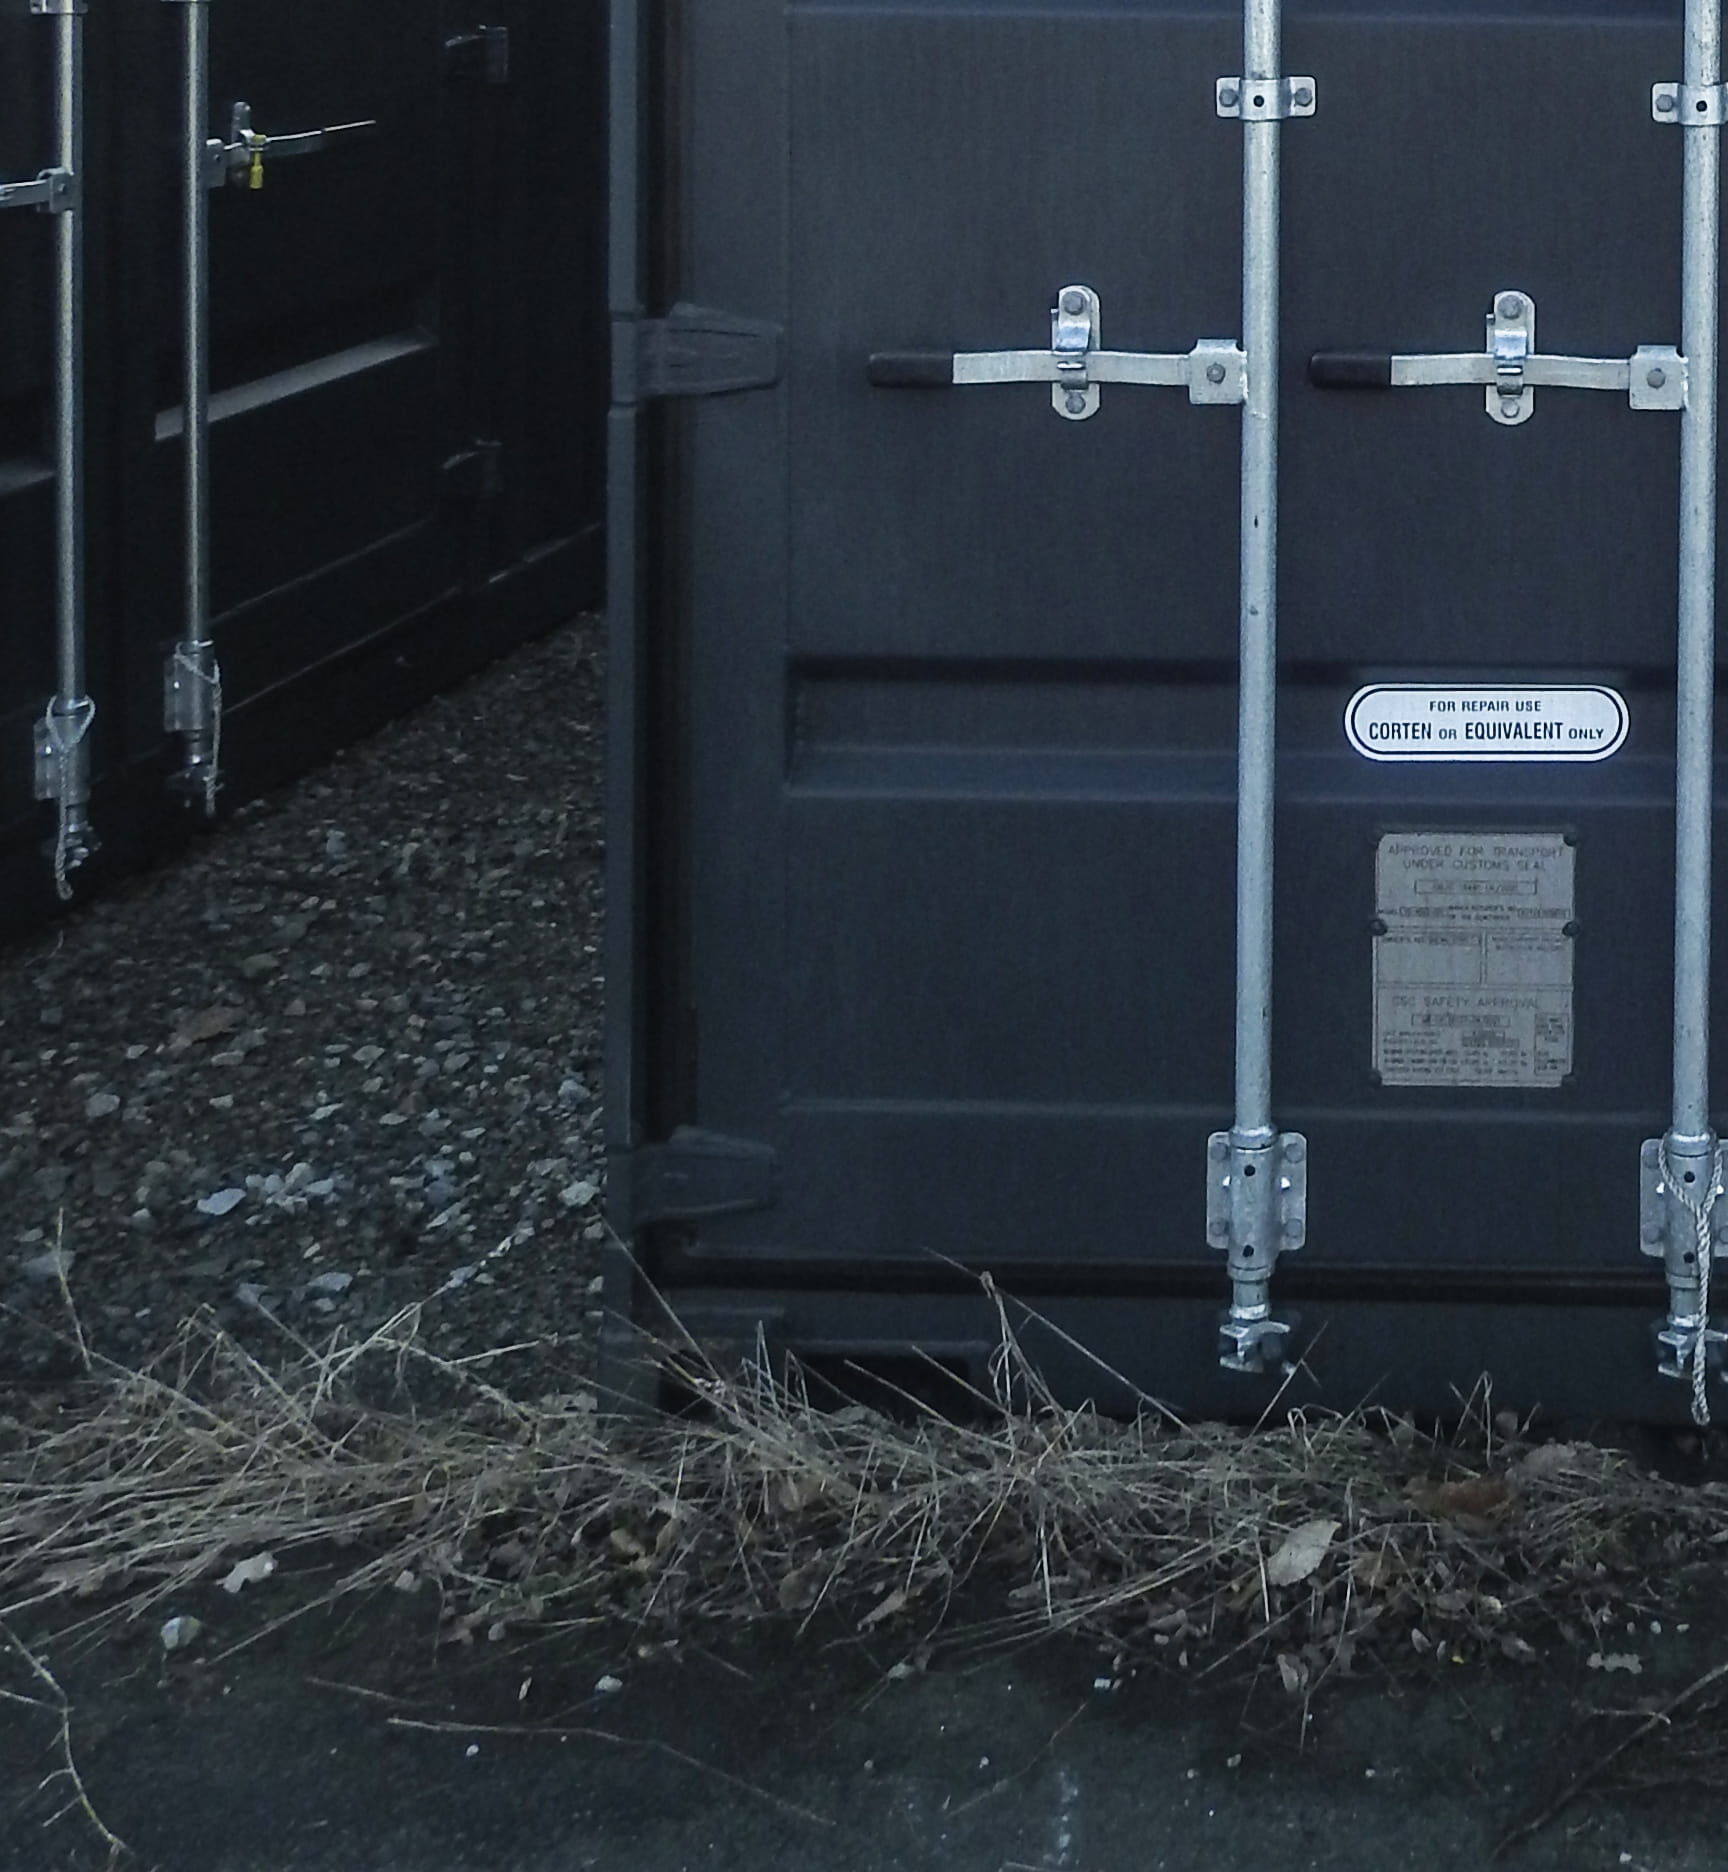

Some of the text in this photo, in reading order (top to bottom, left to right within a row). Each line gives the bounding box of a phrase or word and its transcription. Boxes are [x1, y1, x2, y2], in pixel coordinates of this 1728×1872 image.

[1430, 701, 1540, 712] FOR REPAIR USE
[1370, 722, 1603, 739] CORTEN OR EQUIVALENT ONLY
